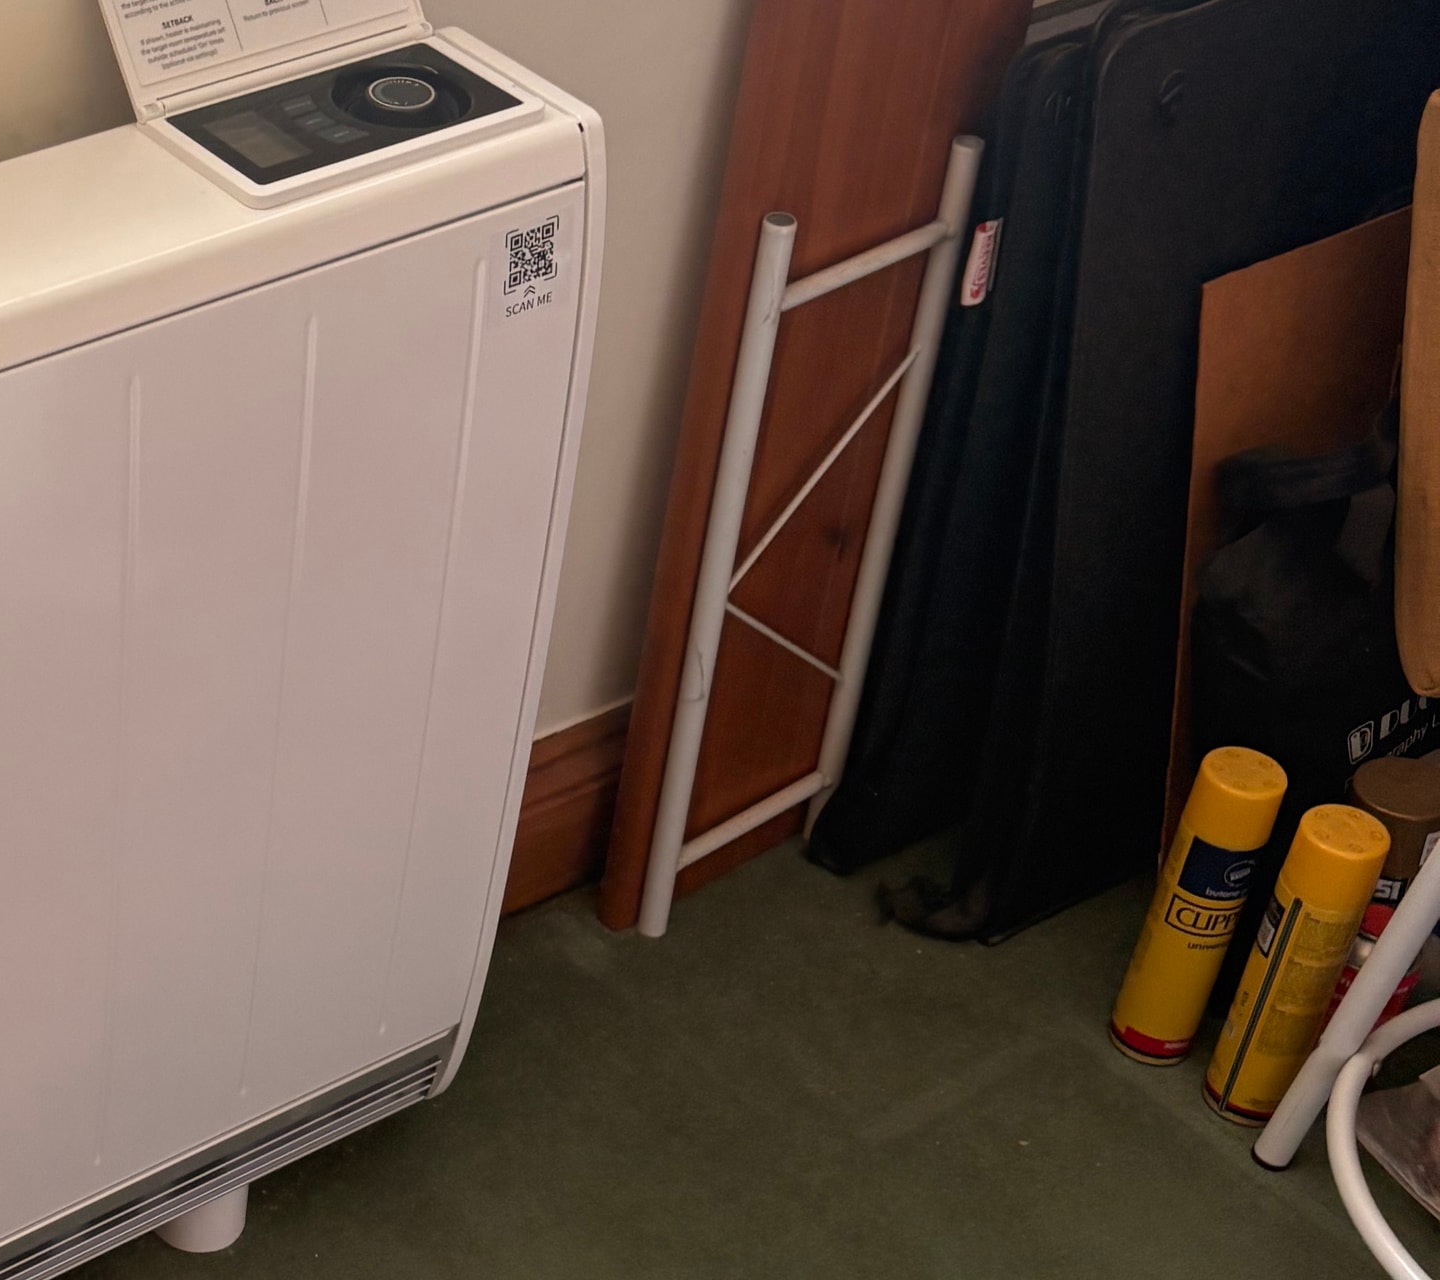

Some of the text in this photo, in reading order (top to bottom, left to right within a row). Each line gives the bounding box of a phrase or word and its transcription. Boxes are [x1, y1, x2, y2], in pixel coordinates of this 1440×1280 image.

[124, 7, 152, 19] according
[162, 15, 193, 29] SETBACK
[243, 12, 261, 21] Return
[268, 4, 291, 16] previous
[189, 19, 221, 31] maintaining
[151, 43, 168, 52] target
[168, 39, 183, 47] room
[183, 30, 216, 43] temperature
[147, 53, 168, 63] outside
[169, 44, 197, 57] scheduled
[505, 291, 553, 317] SCAN ME
[1386, 723, 1428, 757] raphy
[1176, 908, 1240, 930] CLIPP
